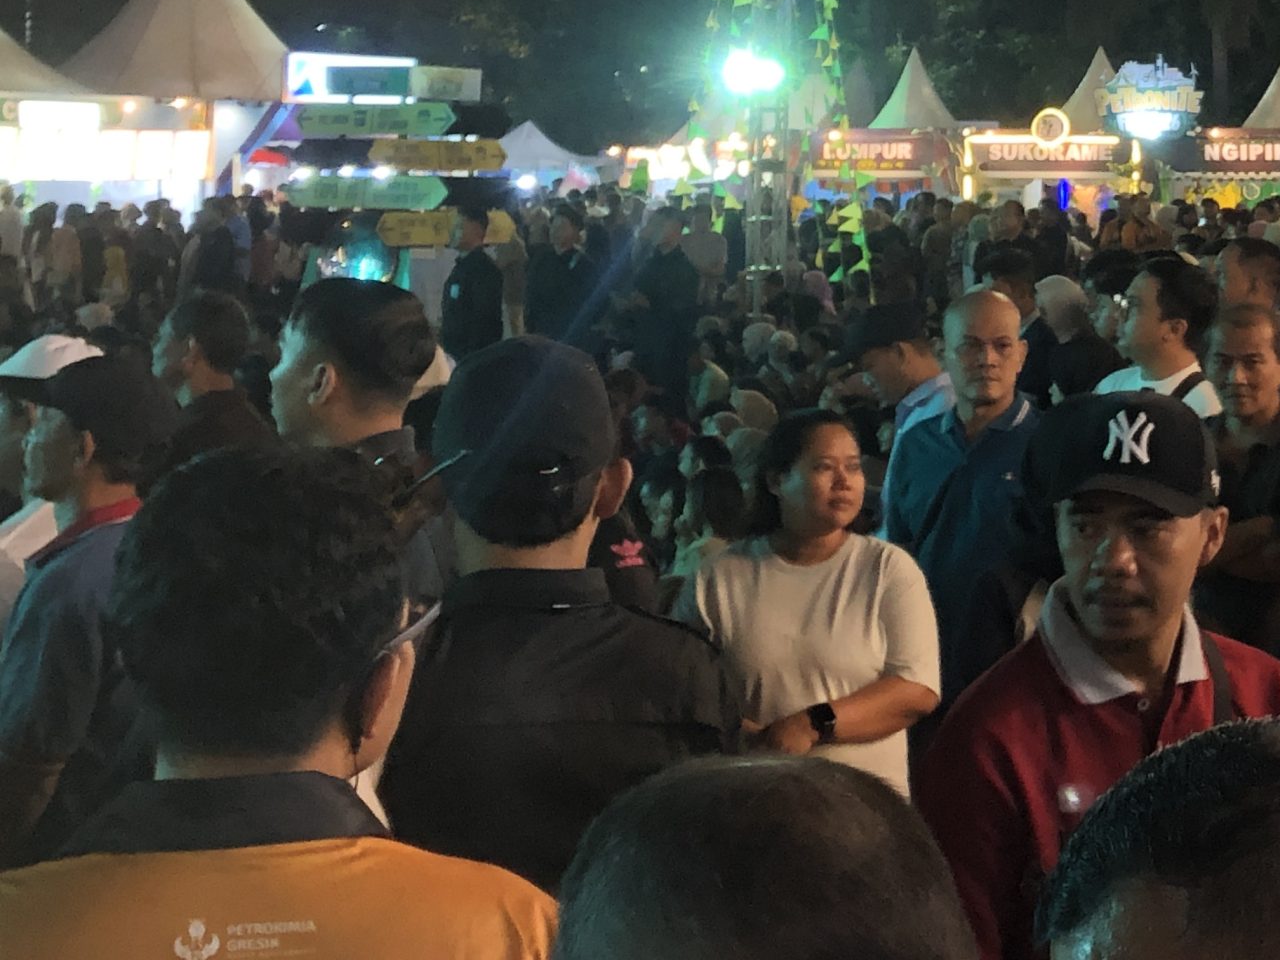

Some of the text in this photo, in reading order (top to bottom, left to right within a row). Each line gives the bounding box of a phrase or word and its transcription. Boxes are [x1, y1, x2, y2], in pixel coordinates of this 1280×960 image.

[988, 143, 1113, 161] SUKORAME
[1103, 409, 1155, 464] NY
[227, 920, 316, 935] PETROKIMIA
[227, 938, 280, 951] GRESIK
